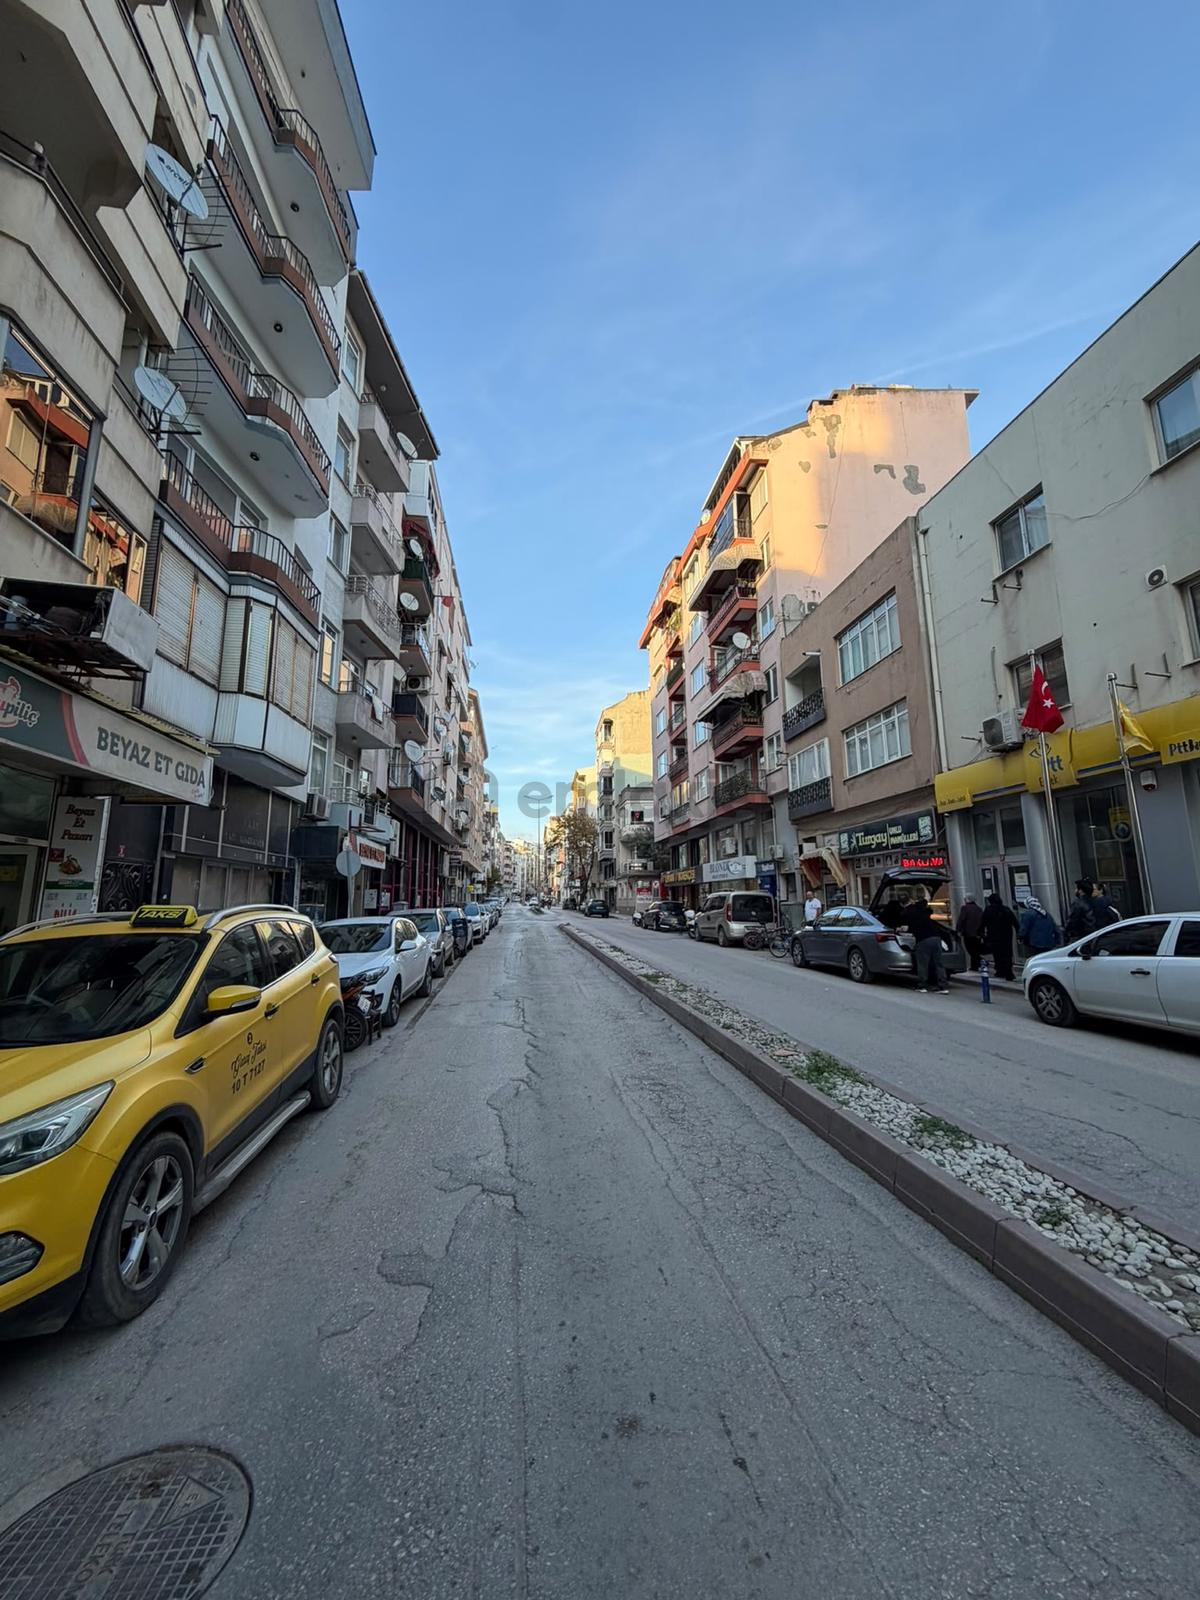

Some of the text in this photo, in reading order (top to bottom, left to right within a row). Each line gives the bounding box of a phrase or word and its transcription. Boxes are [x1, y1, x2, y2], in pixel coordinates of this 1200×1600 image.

[0, 700, 40, 727] piliç
[97, 726, 205, 789] BEYAZ ET GIDA
[1043, 755, 1065, 773] tt
[855, 831, 887, 849] Turgay
